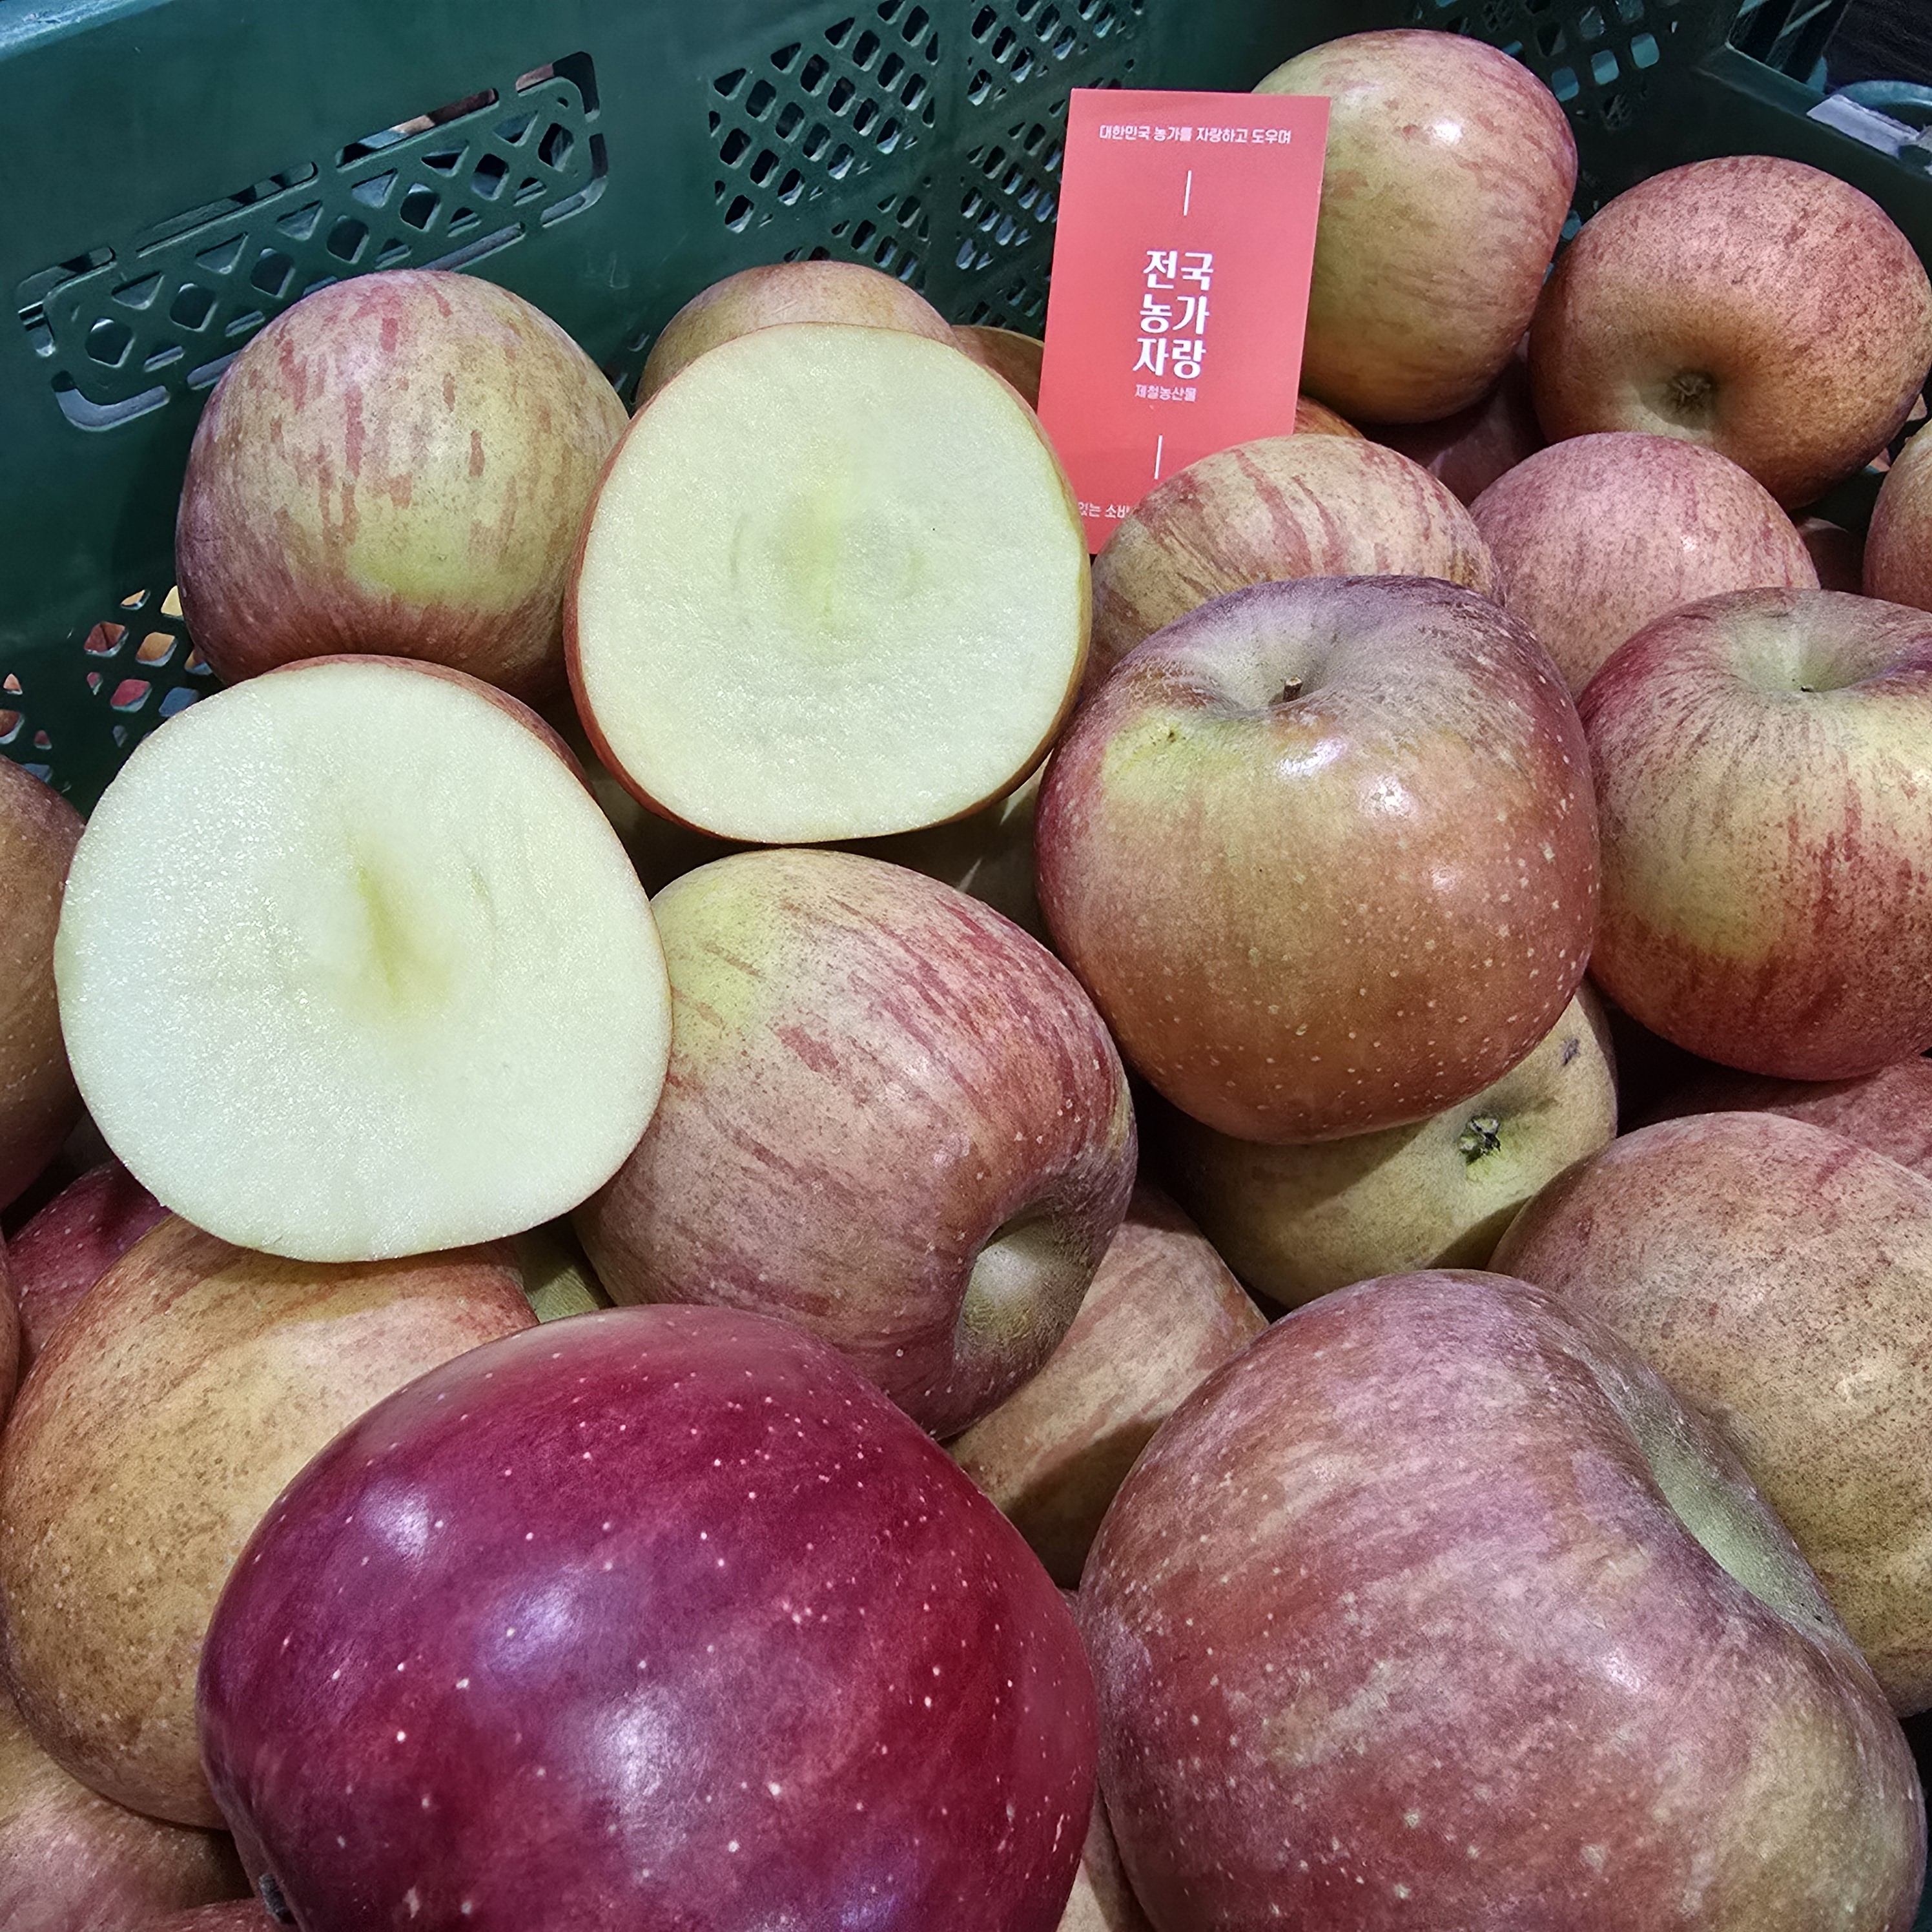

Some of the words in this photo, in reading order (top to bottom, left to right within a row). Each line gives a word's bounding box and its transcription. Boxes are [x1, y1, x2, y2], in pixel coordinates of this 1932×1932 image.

[1099, 125, 1151, 141] 대한민국
[1153, 126, 1193, 142] 농가를
[1197, 127, 1248, 143] 자랑하고
[1251, 128, 1291, 144] 도우며
[1143, 251, 1214, 291] 전국
[1140, 294, 1209, 334] 농가
[1133, 338, 1206, 379] 자랑
[1135, 384, 1197, 402] 제철농산물
